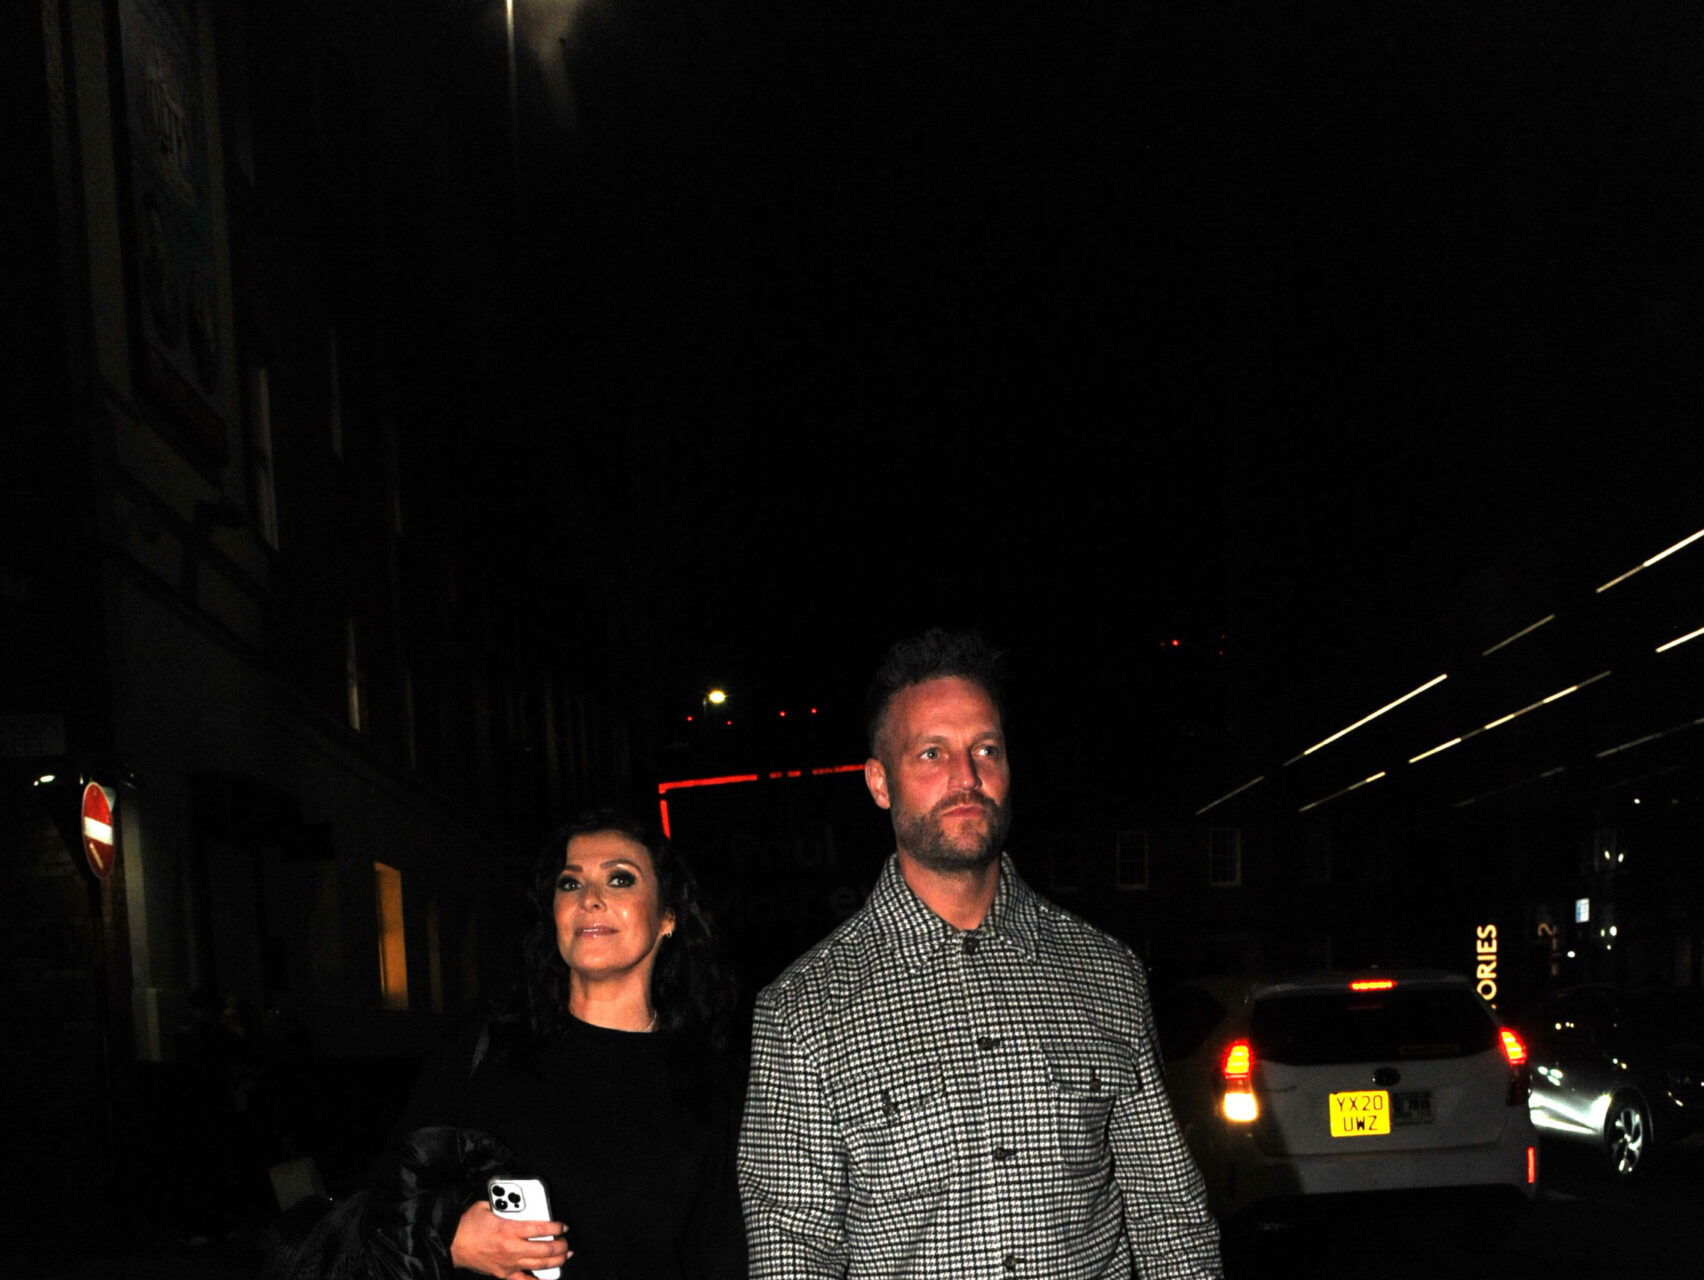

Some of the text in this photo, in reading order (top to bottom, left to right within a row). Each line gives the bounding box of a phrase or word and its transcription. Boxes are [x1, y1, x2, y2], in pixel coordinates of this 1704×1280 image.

[1475, 923, 1498, 1010] ORIES
[1336, 1094, 1383, 1112] YX20
[1342, 1115, 1378, 1132] UWZ
